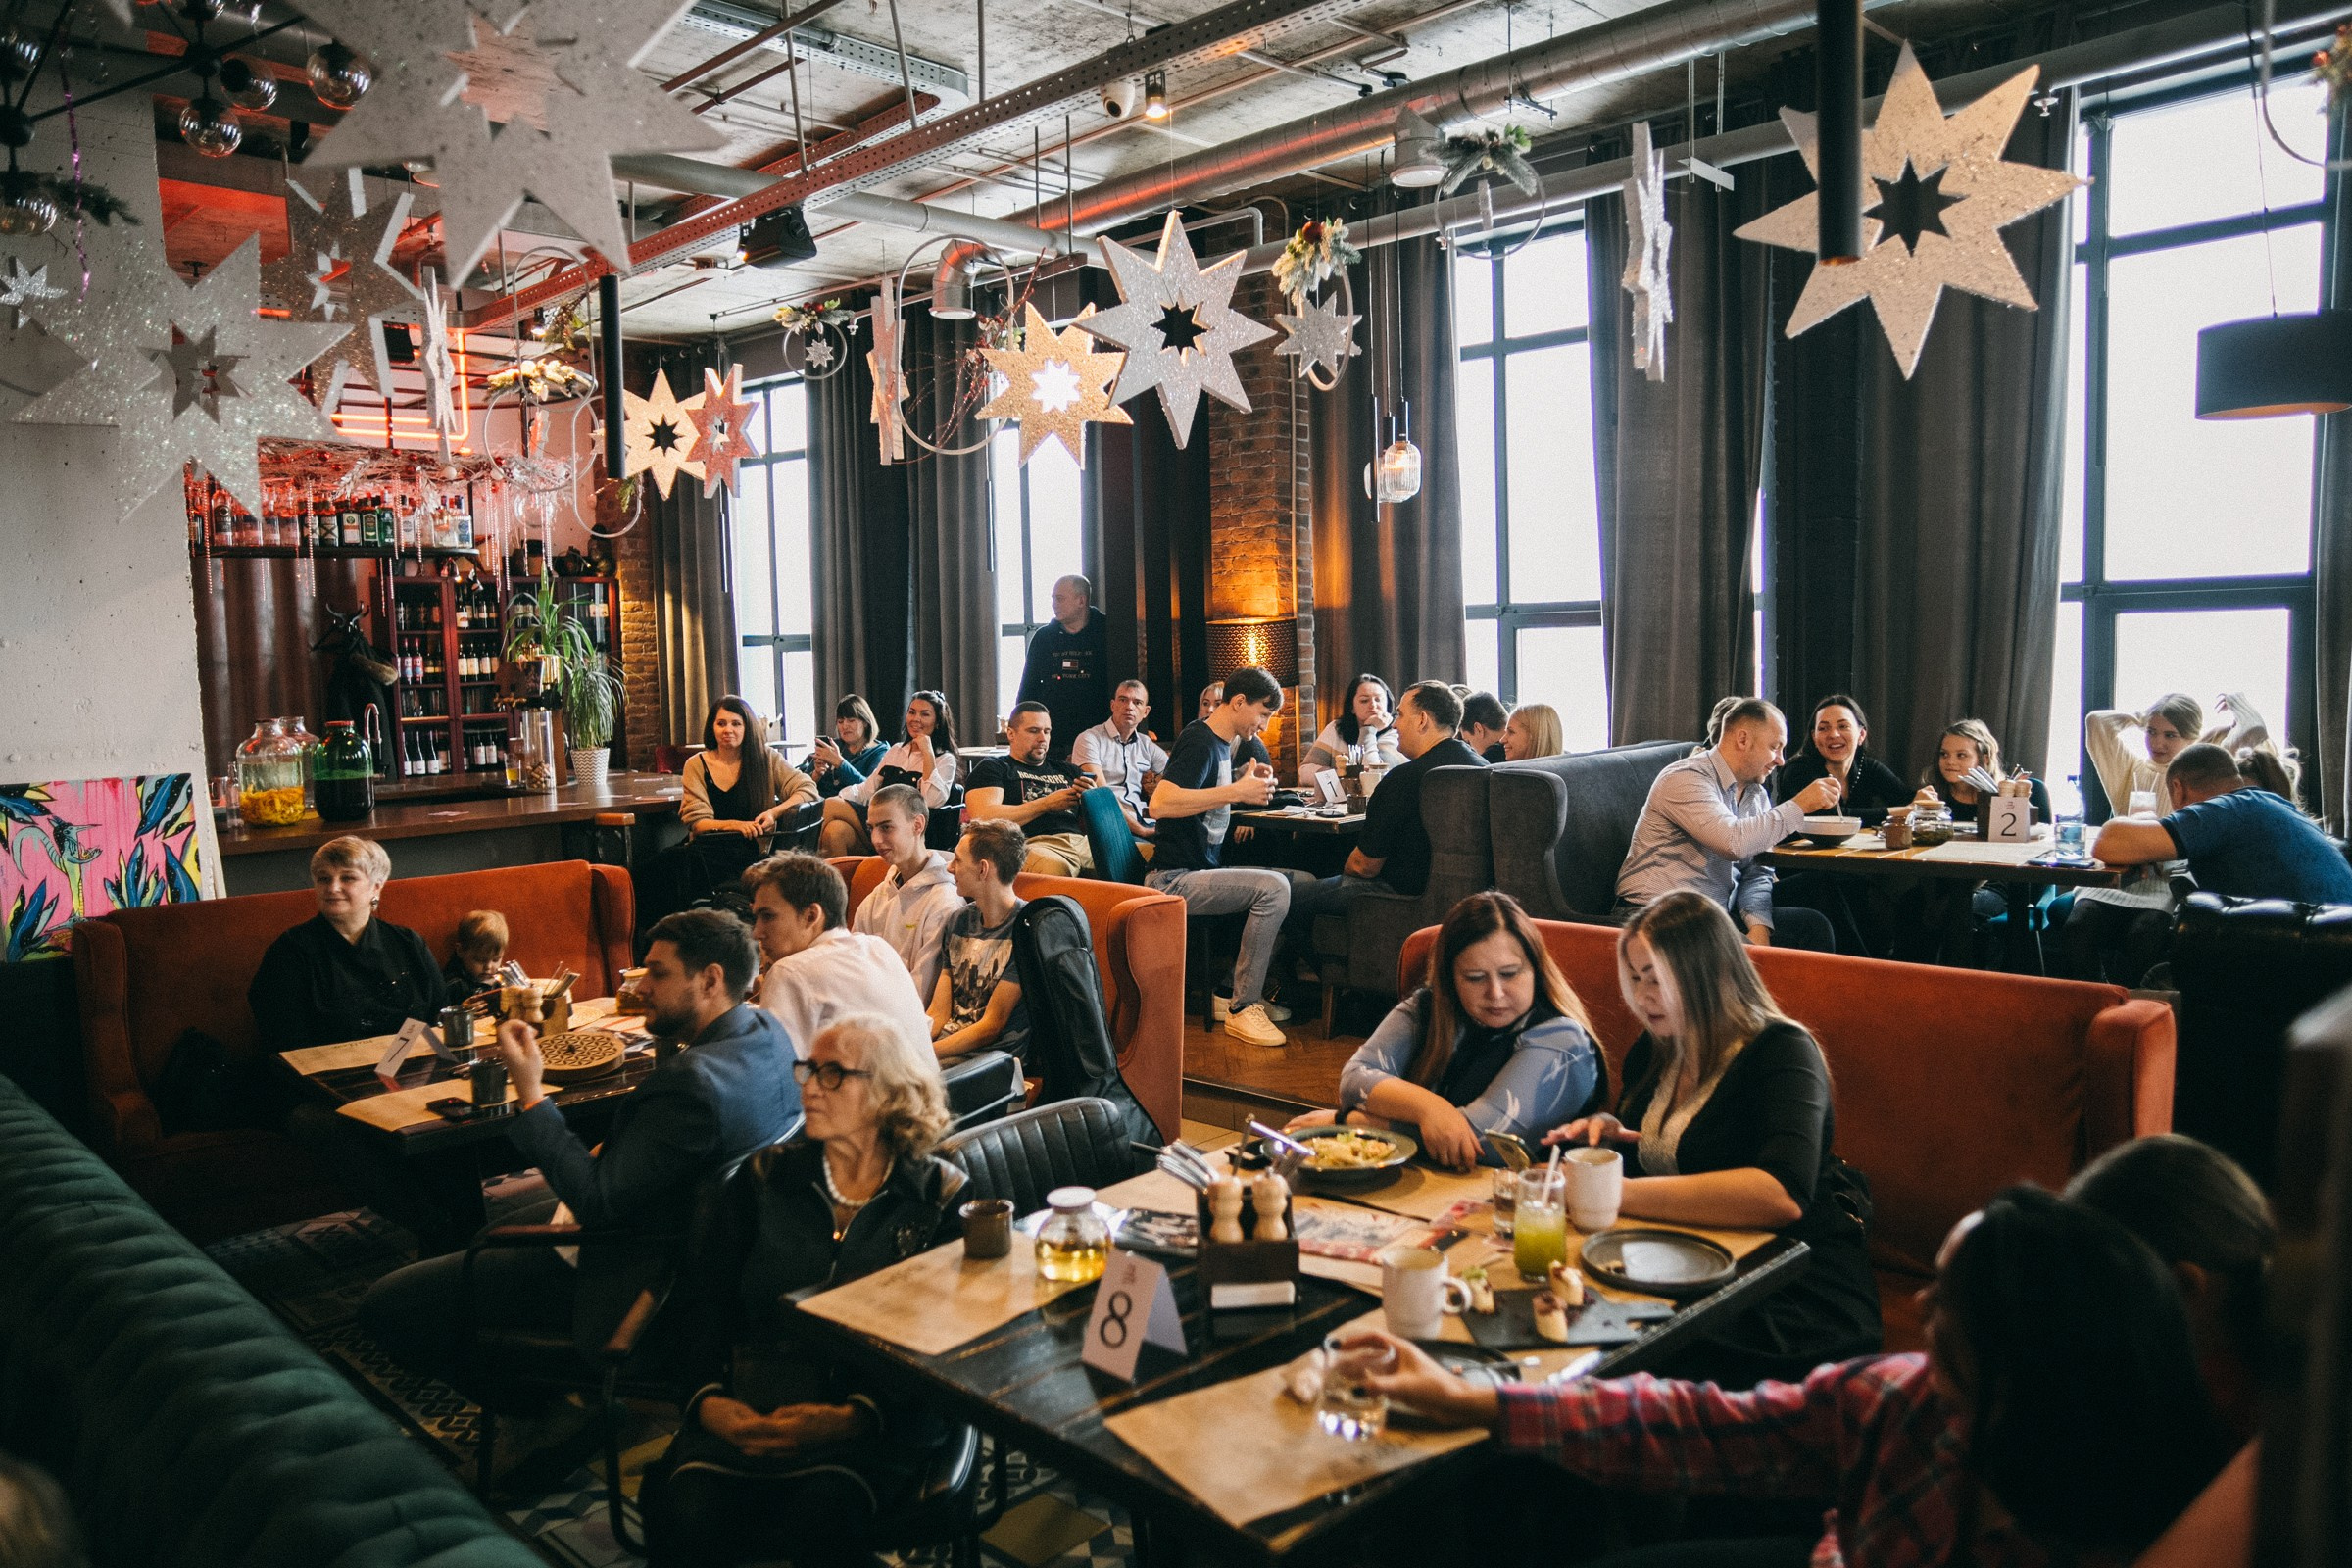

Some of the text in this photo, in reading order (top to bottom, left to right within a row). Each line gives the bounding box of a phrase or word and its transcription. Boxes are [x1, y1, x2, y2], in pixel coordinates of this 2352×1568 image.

[1327, 780, 1338, 798] 1
[2001, 812, 2017, 837] 2
[388, 1036, 410, 1063] 7
[1100, 1290, 1133, 1349] 8
